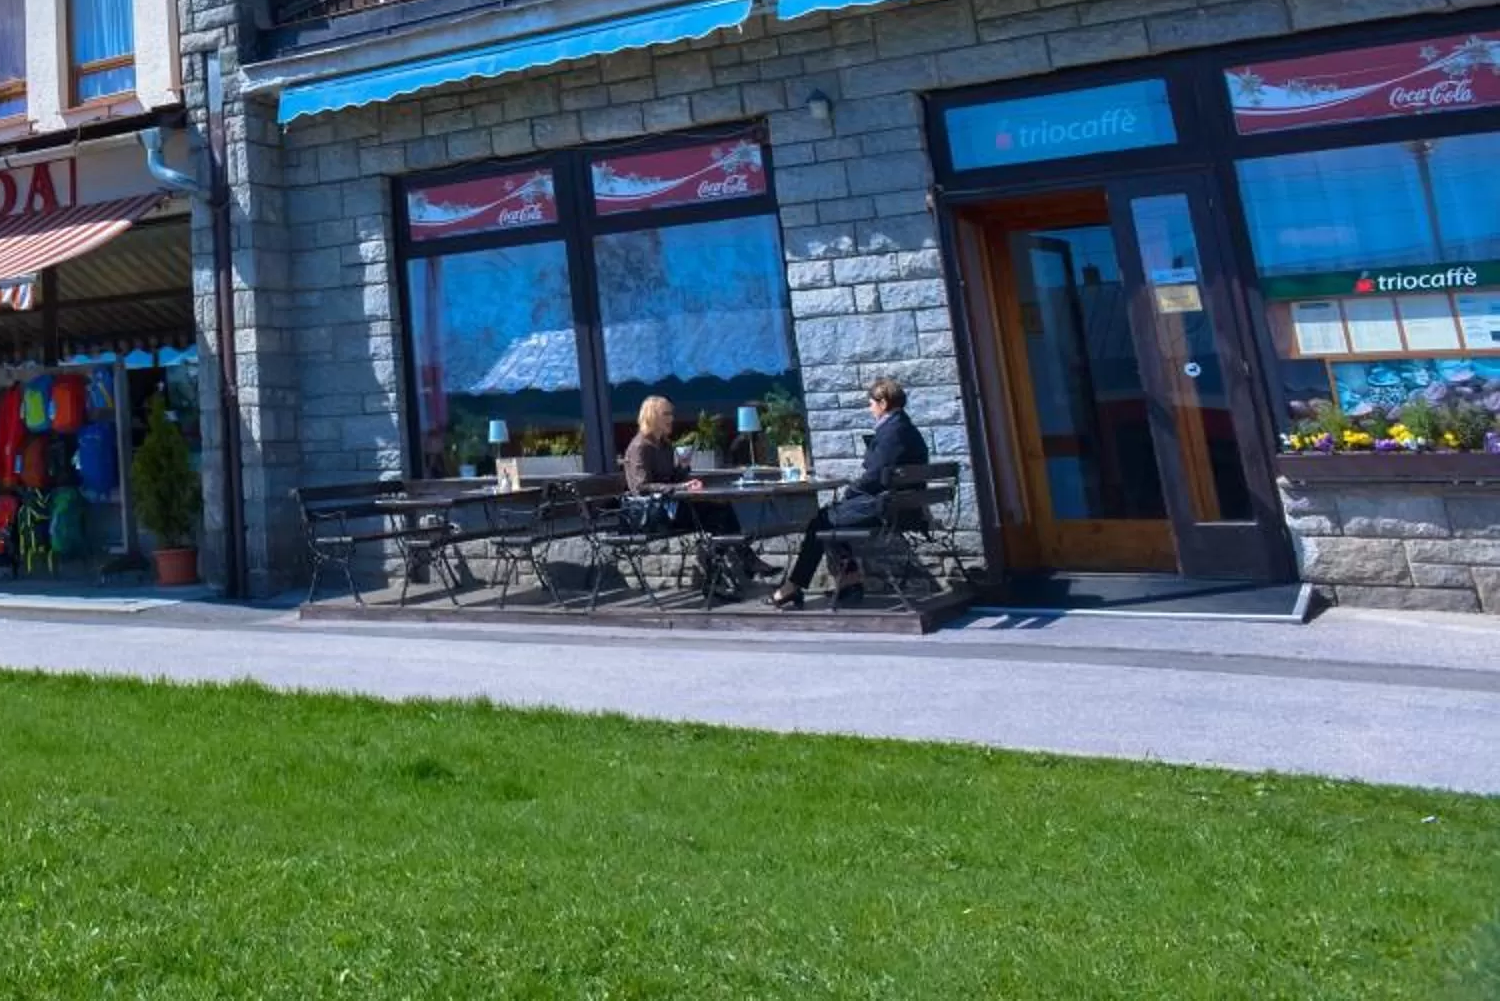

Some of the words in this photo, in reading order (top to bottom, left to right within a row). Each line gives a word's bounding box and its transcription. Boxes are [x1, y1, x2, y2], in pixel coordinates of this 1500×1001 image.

[1388, 79, 1476, 110] Coca-Cola
[1019, 108, 1137, 148] triocaffè
[1377, 266, 1478, 292] triocaffè
